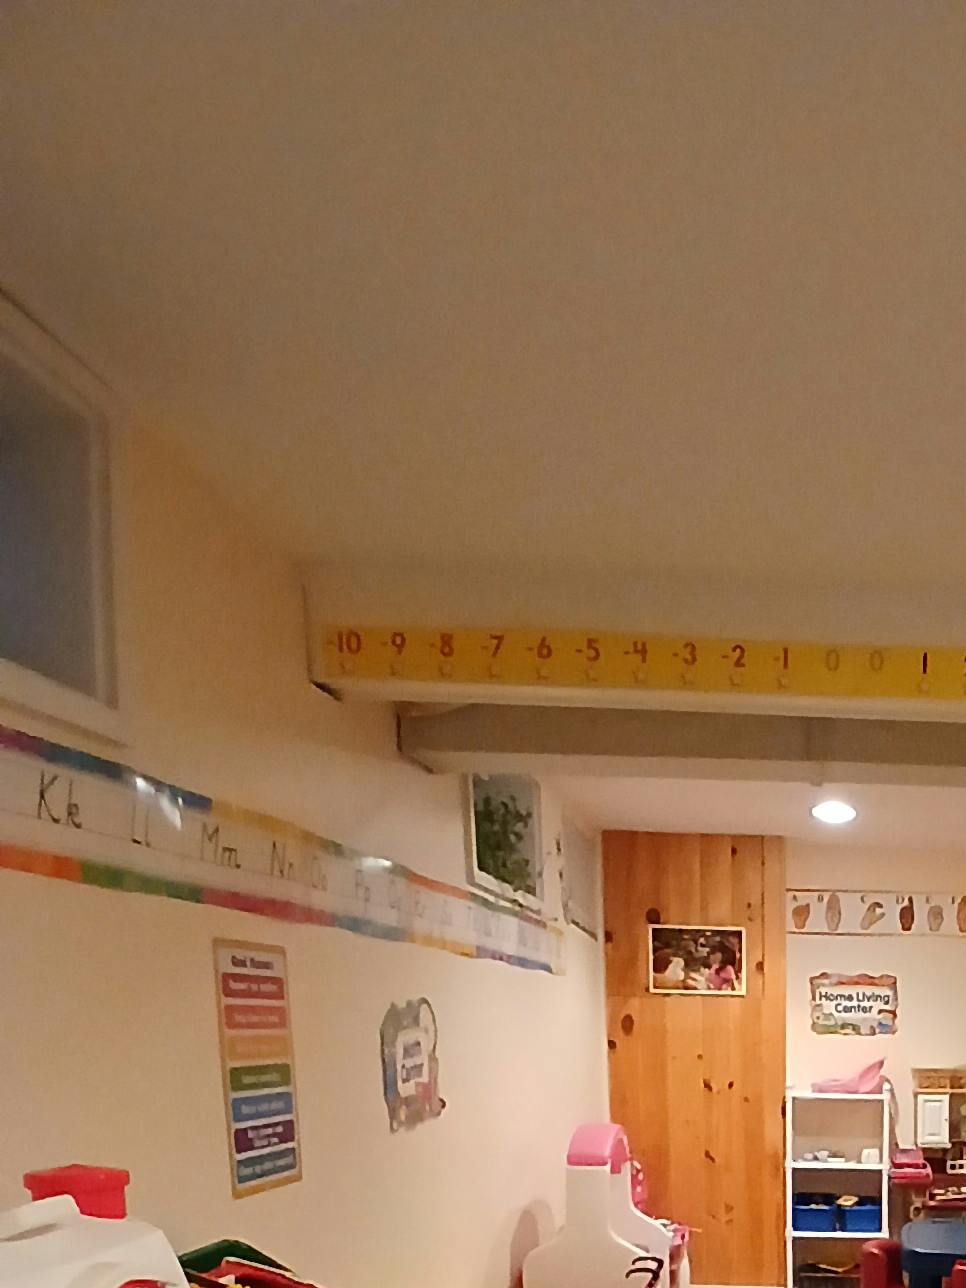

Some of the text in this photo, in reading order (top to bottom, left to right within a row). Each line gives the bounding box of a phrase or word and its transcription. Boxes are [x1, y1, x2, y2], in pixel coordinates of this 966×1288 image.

[921, 651, 928, 675] 1
[37, 770, 83, 829] Kk
[200, 820, 242, 869] Mm
[818, 991, 890, 1005] Home Living
[834, 1003, 874, 1014] Center
